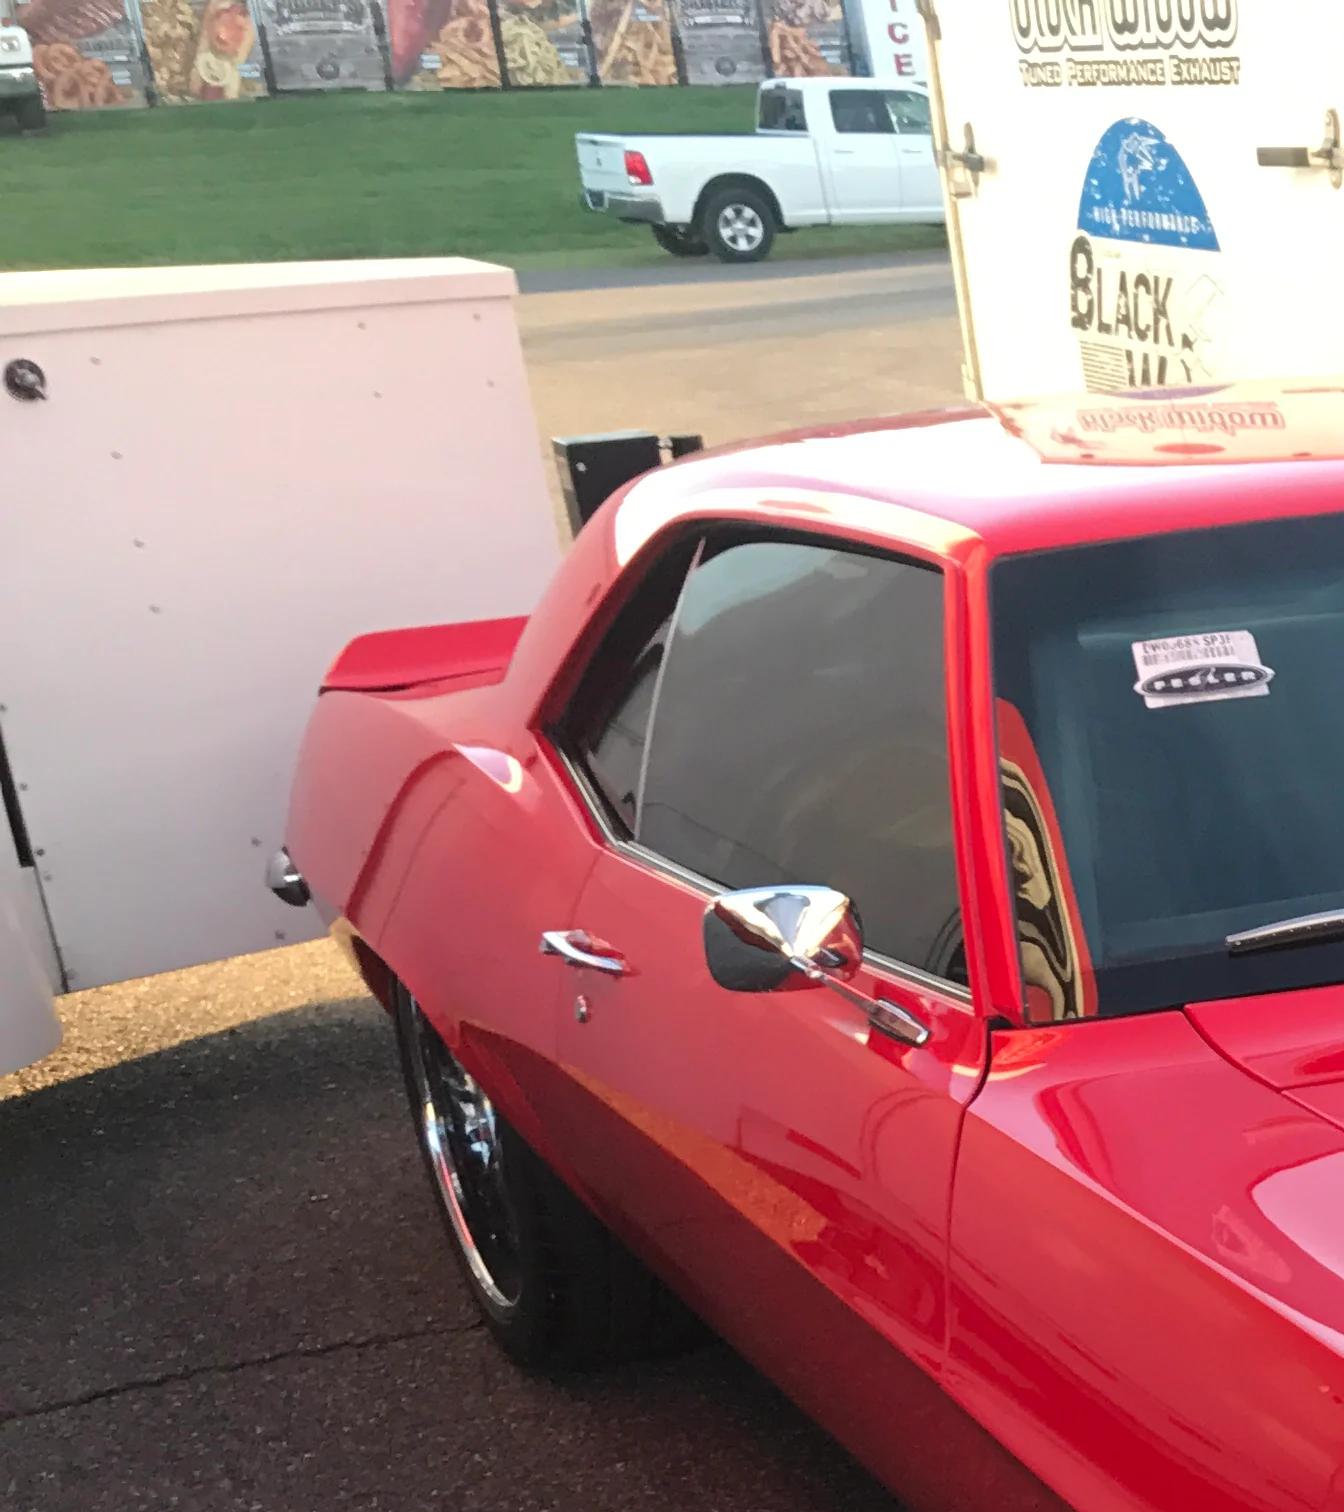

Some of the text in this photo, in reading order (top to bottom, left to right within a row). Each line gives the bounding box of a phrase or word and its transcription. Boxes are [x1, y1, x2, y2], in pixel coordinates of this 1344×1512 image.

[1019, 55, 1240, 86] TUNED PERFORMANCE EXHAUST
